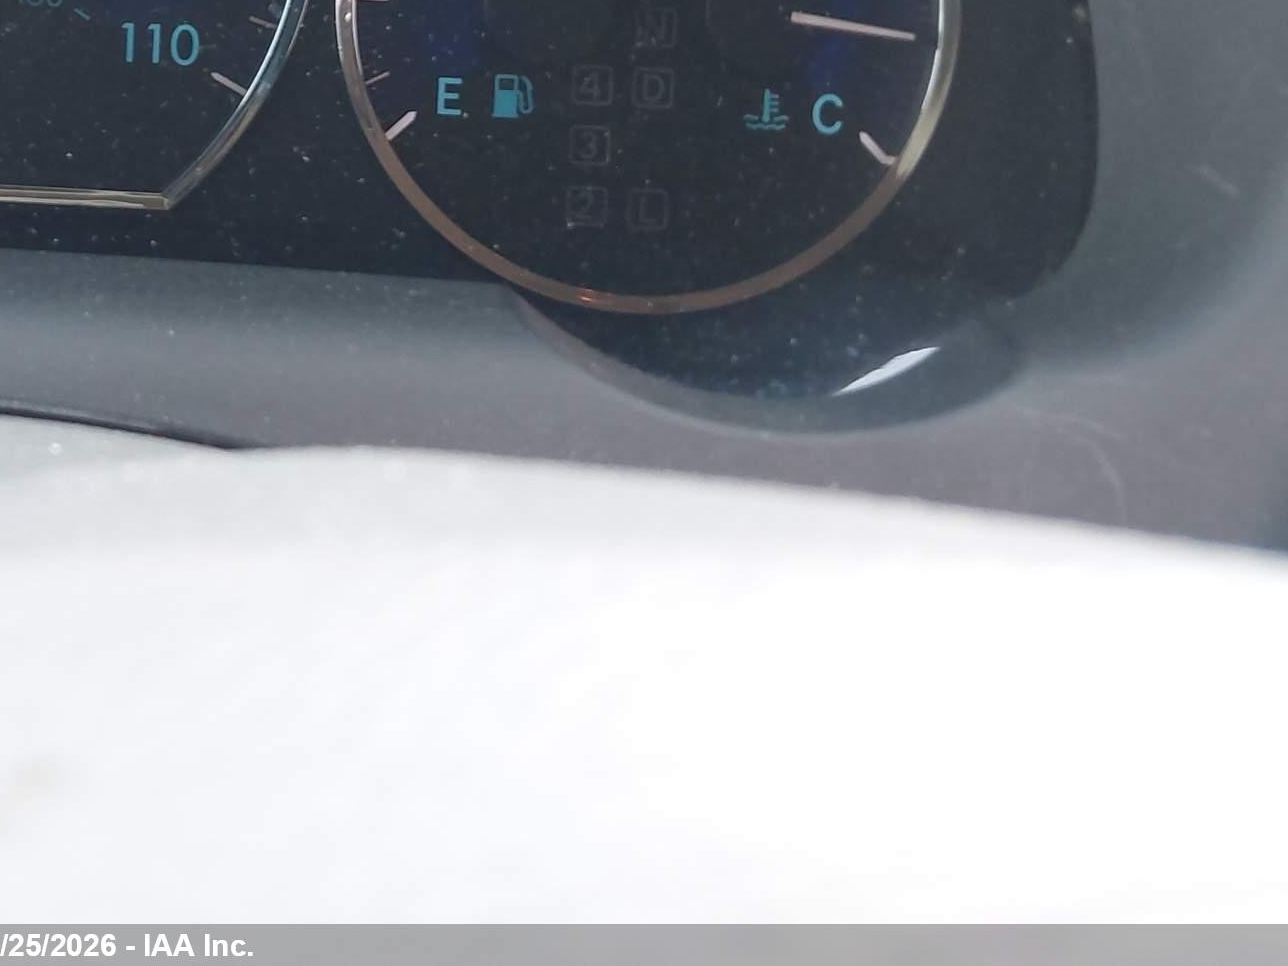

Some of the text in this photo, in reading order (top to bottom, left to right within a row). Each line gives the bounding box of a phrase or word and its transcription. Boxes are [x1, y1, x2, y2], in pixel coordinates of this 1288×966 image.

[121, 22, 200, 66] 110
[436, 76, 463, 116] E
[812, 94, 843, 134] C
